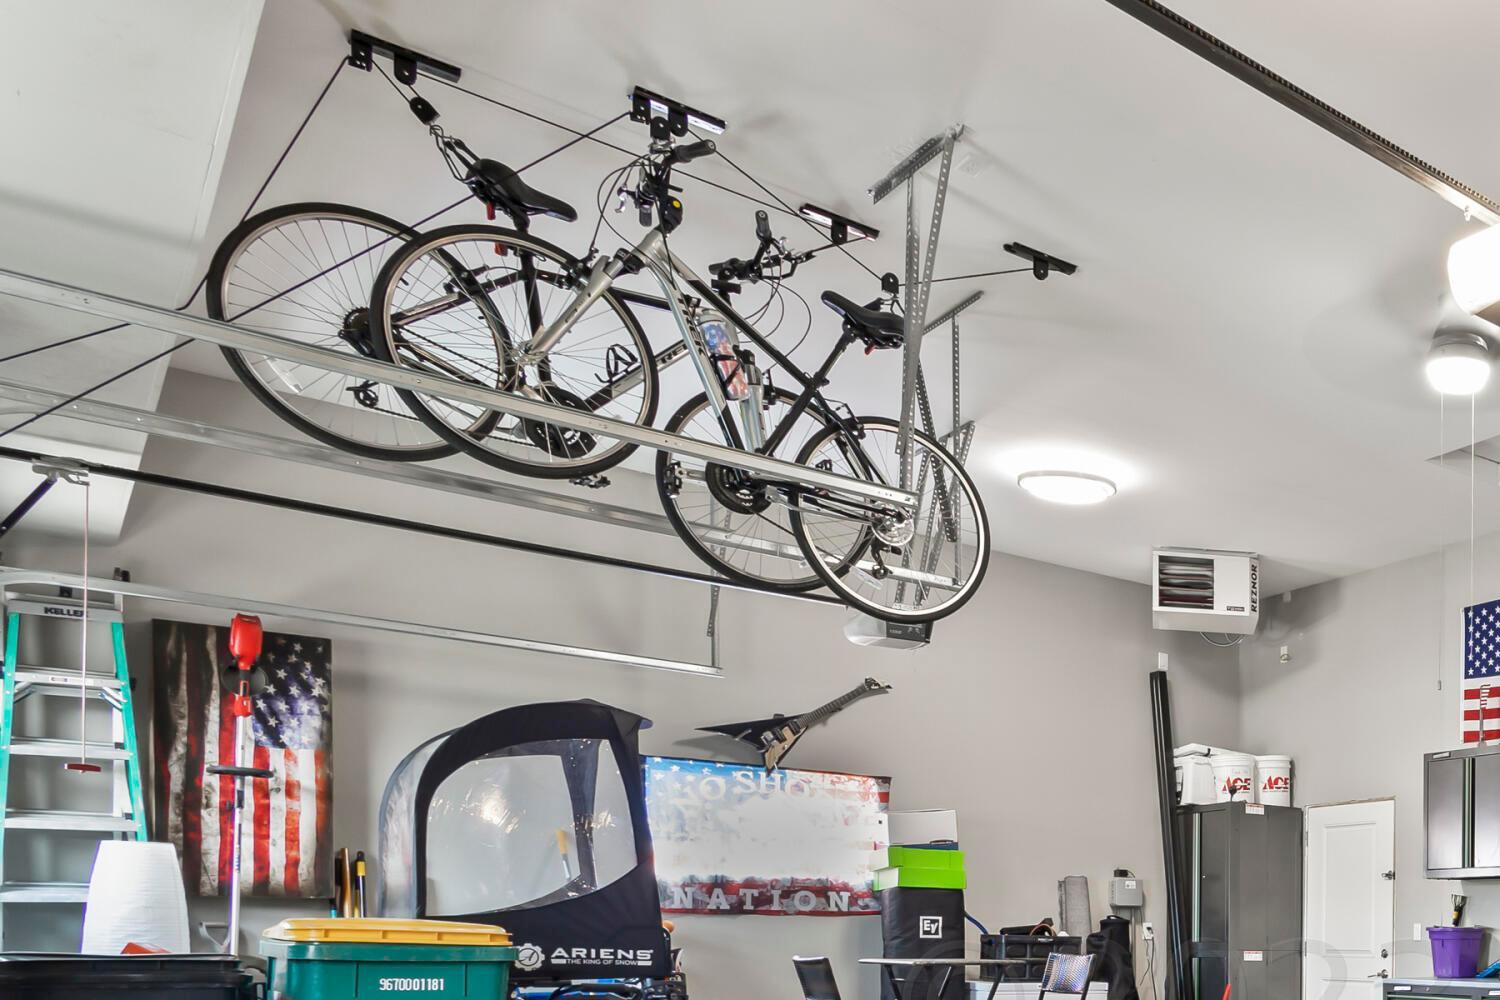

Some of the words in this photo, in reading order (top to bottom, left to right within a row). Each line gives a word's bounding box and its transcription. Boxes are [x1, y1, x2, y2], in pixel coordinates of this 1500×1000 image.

[1250, 563, 1258, 613] REZNOR
[1222, 775, 1252, 792] ACE
[1262, 775, 1290, 790] ACE
[672, 886, 851, 912] NATION
[551, 947, 653, 960] ARIENS
[379, 978, 444, 991] 9670001181
